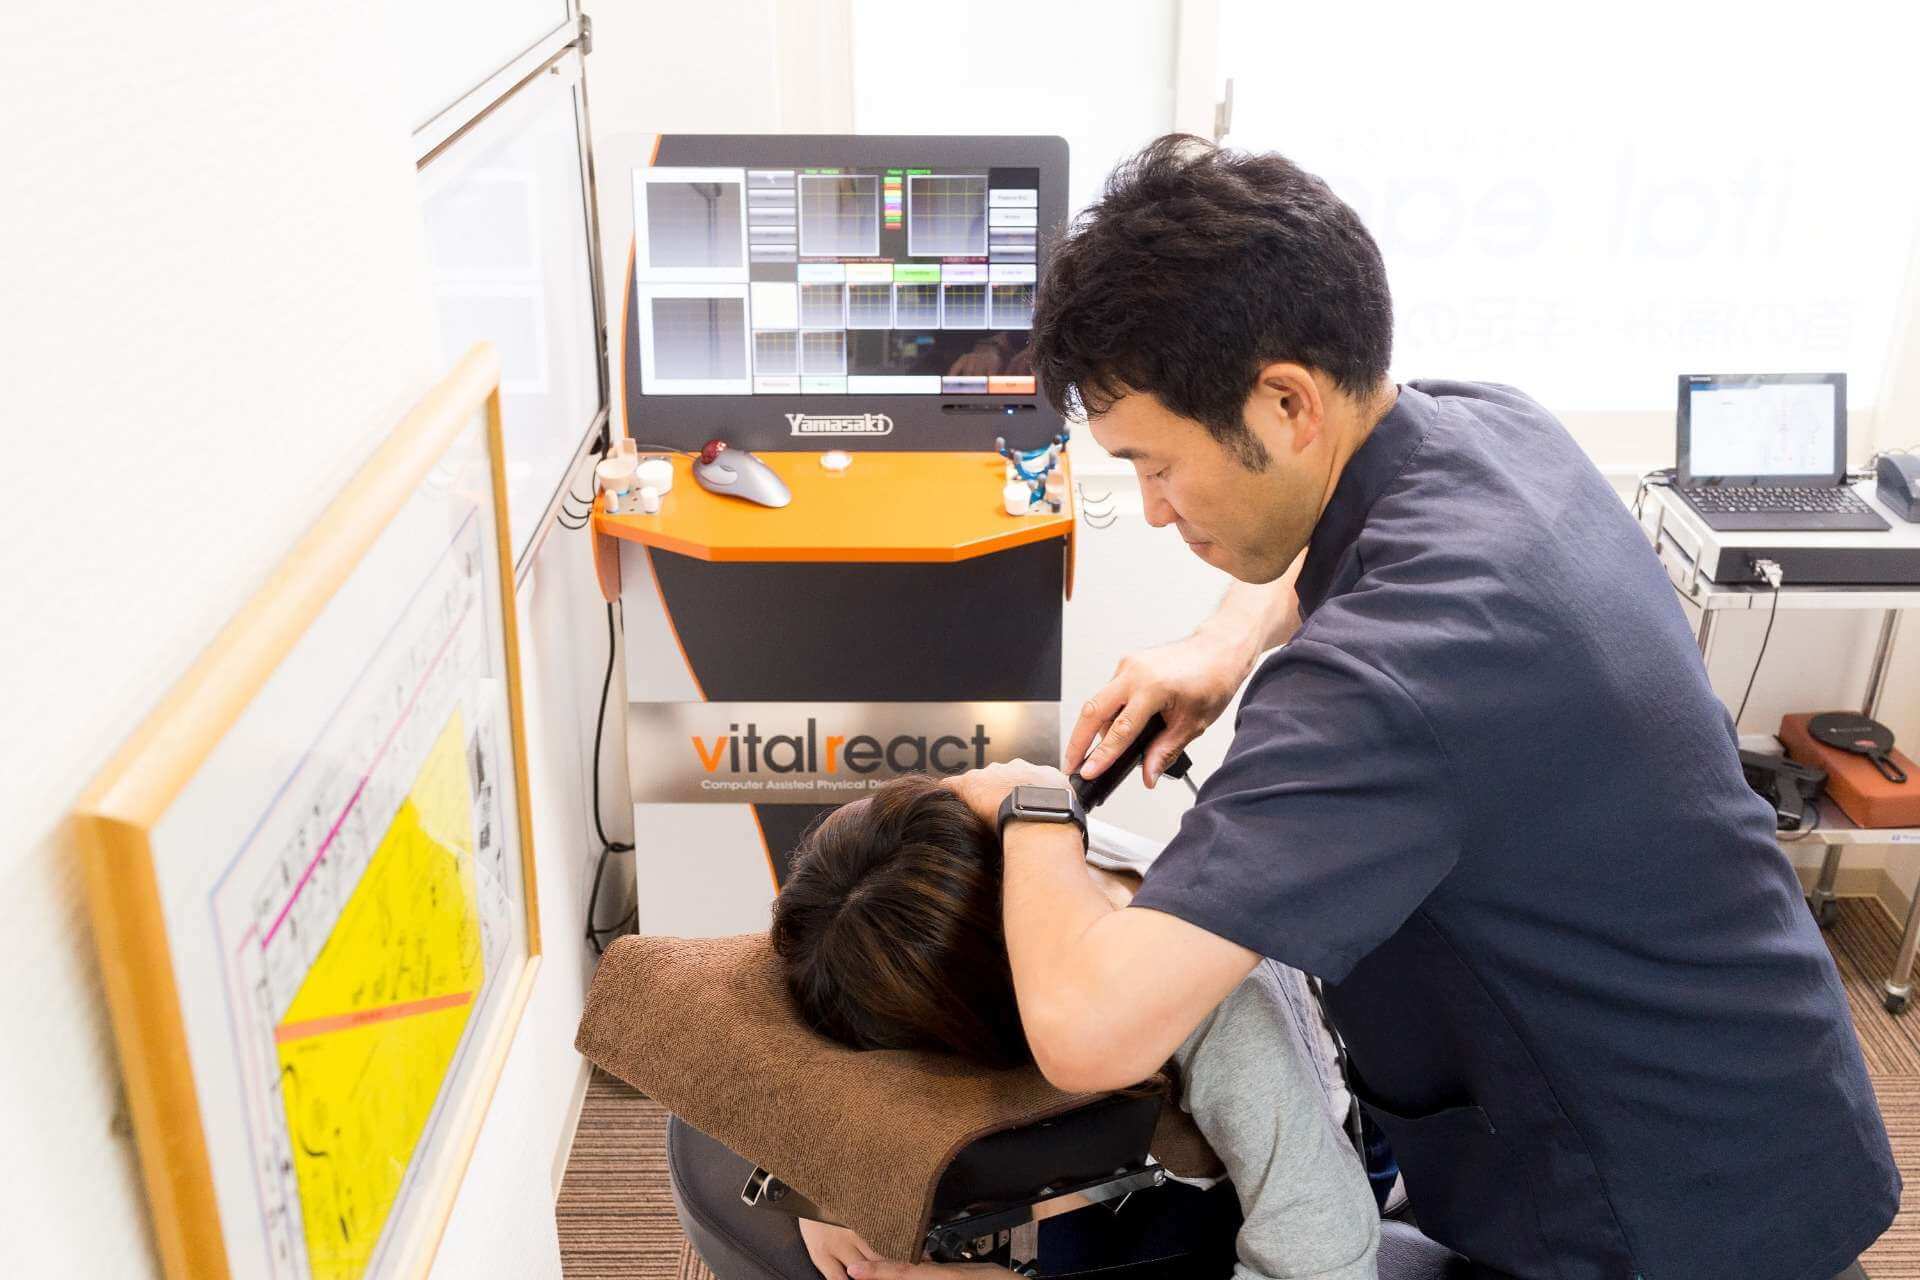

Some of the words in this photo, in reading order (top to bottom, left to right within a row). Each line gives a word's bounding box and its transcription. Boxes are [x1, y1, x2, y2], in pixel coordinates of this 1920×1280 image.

[785, 413, 894, 436] Yamasaki
[701, 779, 762, 791] Computer
[766, 779, 813, 789] Assisted
[817, 779, 865, 791] Physical
